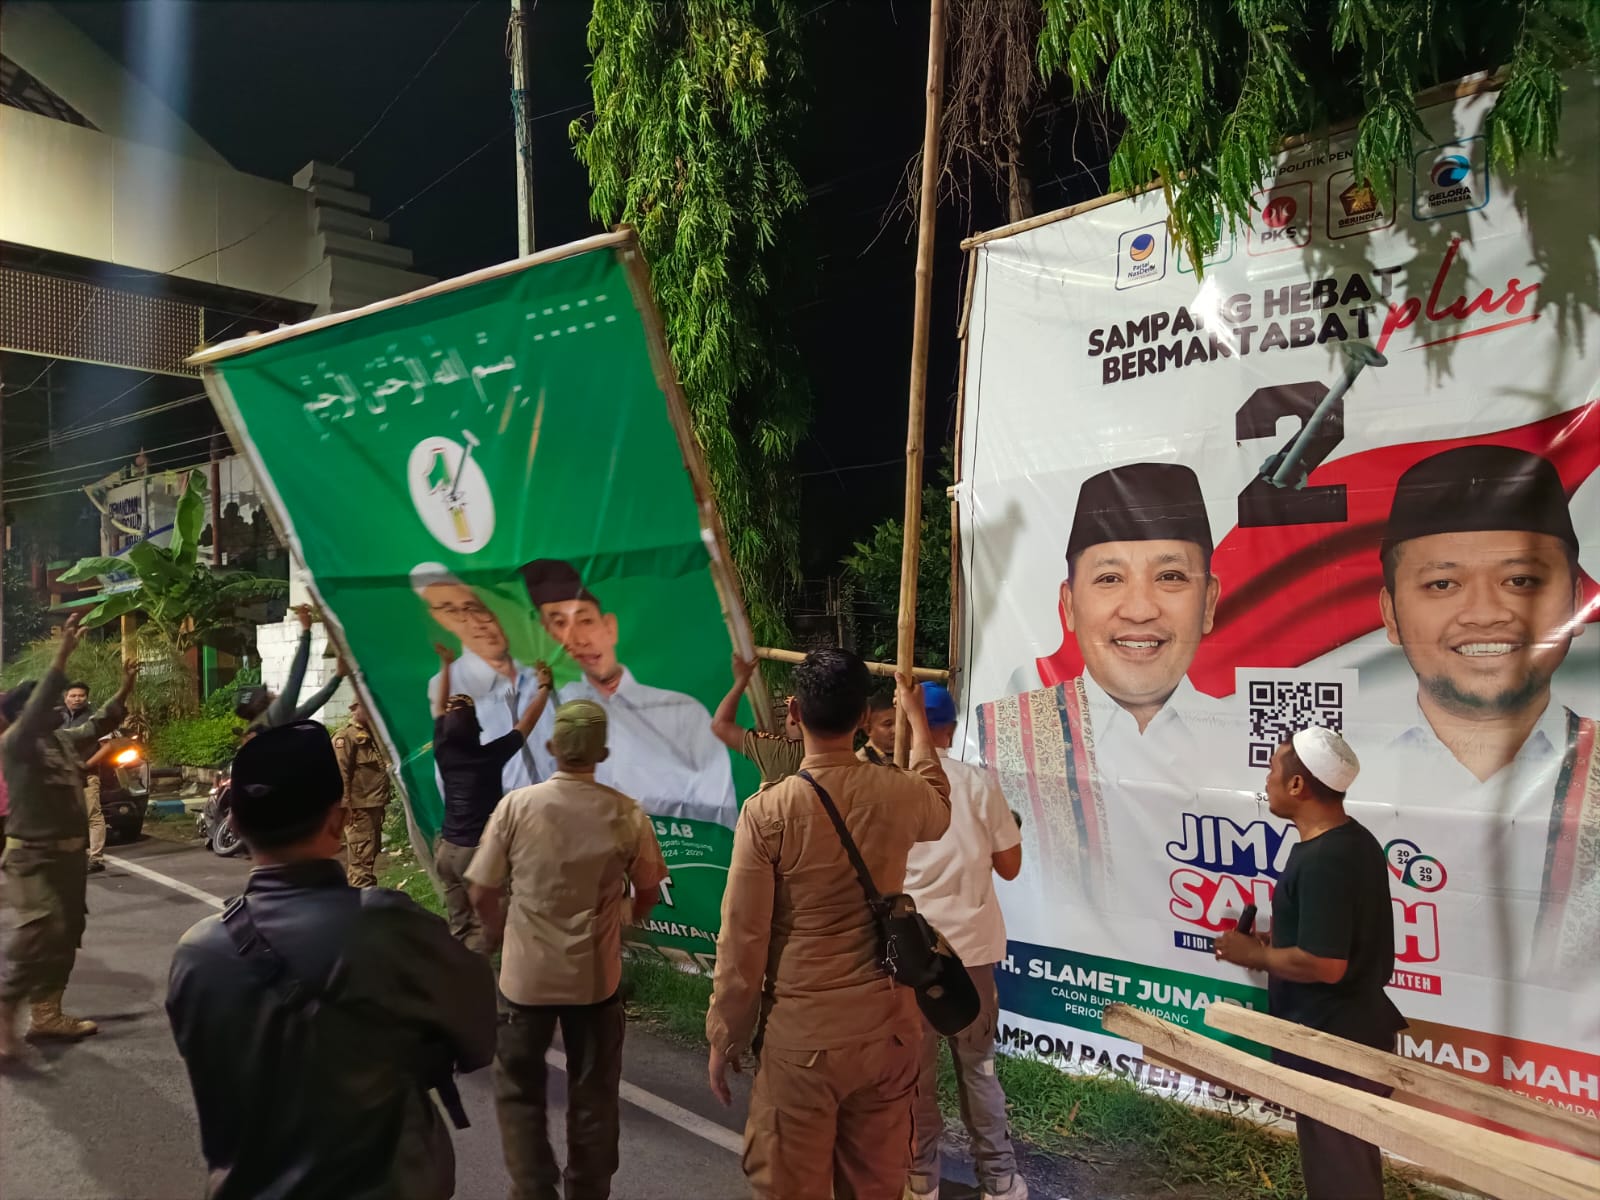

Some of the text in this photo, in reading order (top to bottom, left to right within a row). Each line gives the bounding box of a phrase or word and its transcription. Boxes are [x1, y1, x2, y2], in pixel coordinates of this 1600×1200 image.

[1278, 154, 1326, 178] POLITIK
[1328, 150, 1354, 163] PEN
[1428, 186, 1471, 202] GELORA
[1428, 194, 1472, 208] INDONESIA
[1260, 226, 1298, 244] PKS
[1263, 265, 1402, 319] HEBAT
[1375, 238, 1542, 354] plus
[1235, 380, 1348, 528] 2
[660, 849, 679, 858] 024
[1397, 849, 1410, 858] 20
[1419, 866, 1432, 875] 20
[1419, 874, 1432, 882] 29
[1027, 958, 1132, 996] SLAMET
[1050, 986, 1088, 1003] CALON
